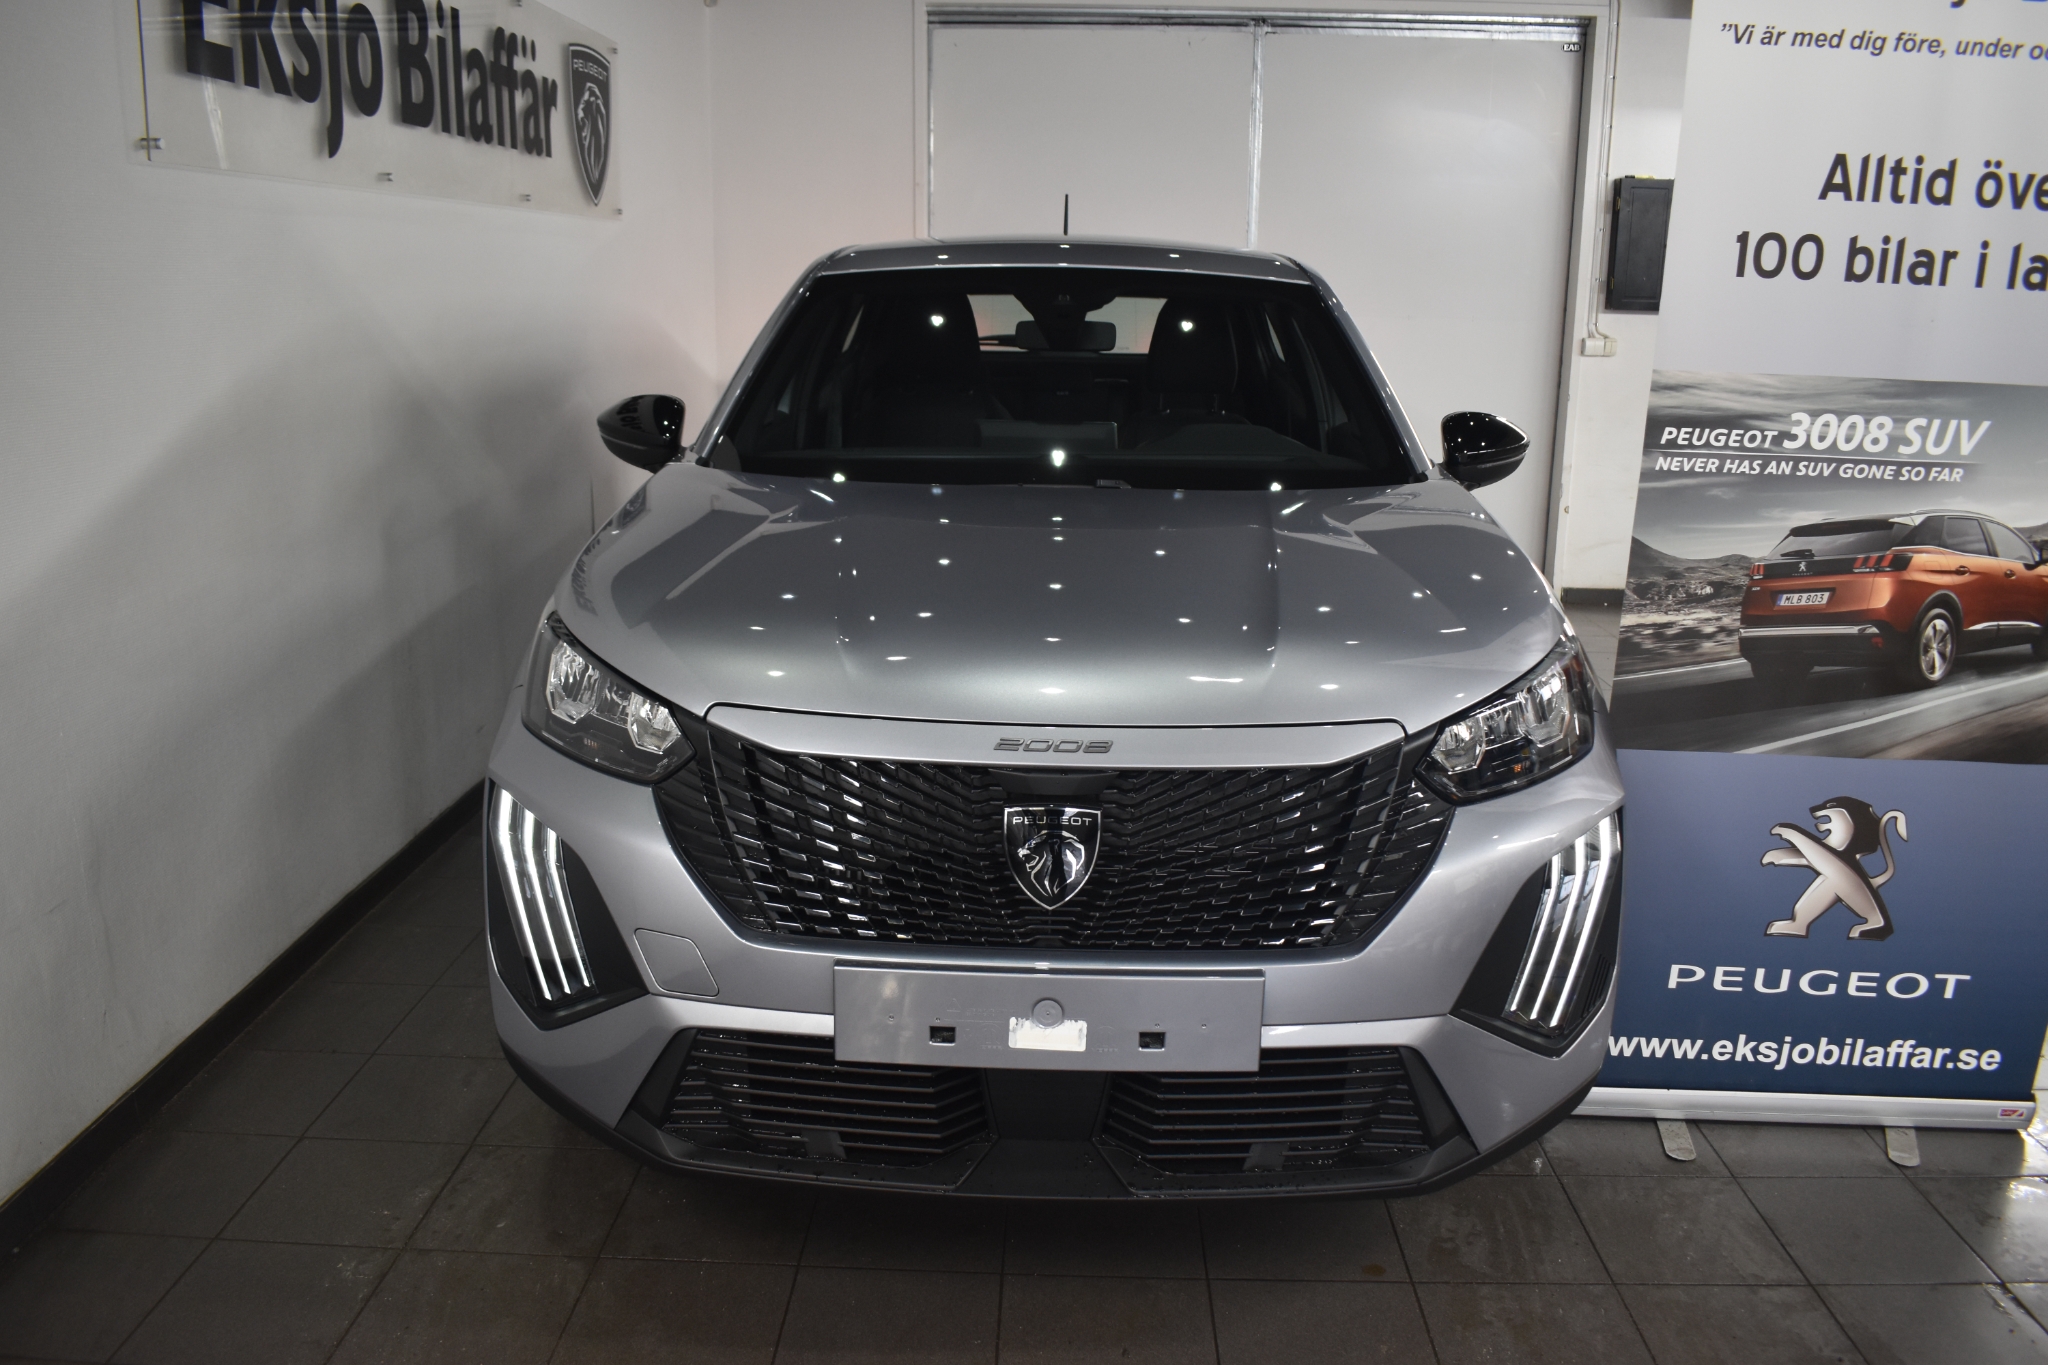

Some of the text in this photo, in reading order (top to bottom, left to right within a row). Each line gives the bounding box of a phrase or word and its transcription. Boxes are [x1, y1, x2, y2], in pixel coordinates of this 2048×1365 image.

[1760, 25, 1786, 46] är
[1790, 28, 1845, 49] med
[1850, 29, 1888, 57] dig
[1893, 32, 1946, 58] före,
[1955, 37, 2024, 59] under
[2029, 43, 2048, 61] o
[396, 0, 558, 159] Bilaffär
[573, 59, 607, 82] PEUGEOT
[1818, 153, 1958, 206] Alltid
[1736, 230, 1825, 281] 100
[1844, 234, 1959, 287] bilar
[1975, 239, 1990, 289] i
[1660, 411, 1992, 456] PEUGEOT 3008 SUV
[1655, 456, 1964, 483] NEVER HAS AN SUV GONE SO FAR
[1784, 593, 1825, 605] MLB 803
[993, 736, 1114, 754] 2008
[1012, 816, 1093, 826] PEUGEOT
[1667, 963, 1971, 1000] PEUGEOT
[1608, 1034, 2002, 1072] www.eksjobilaffar.se
